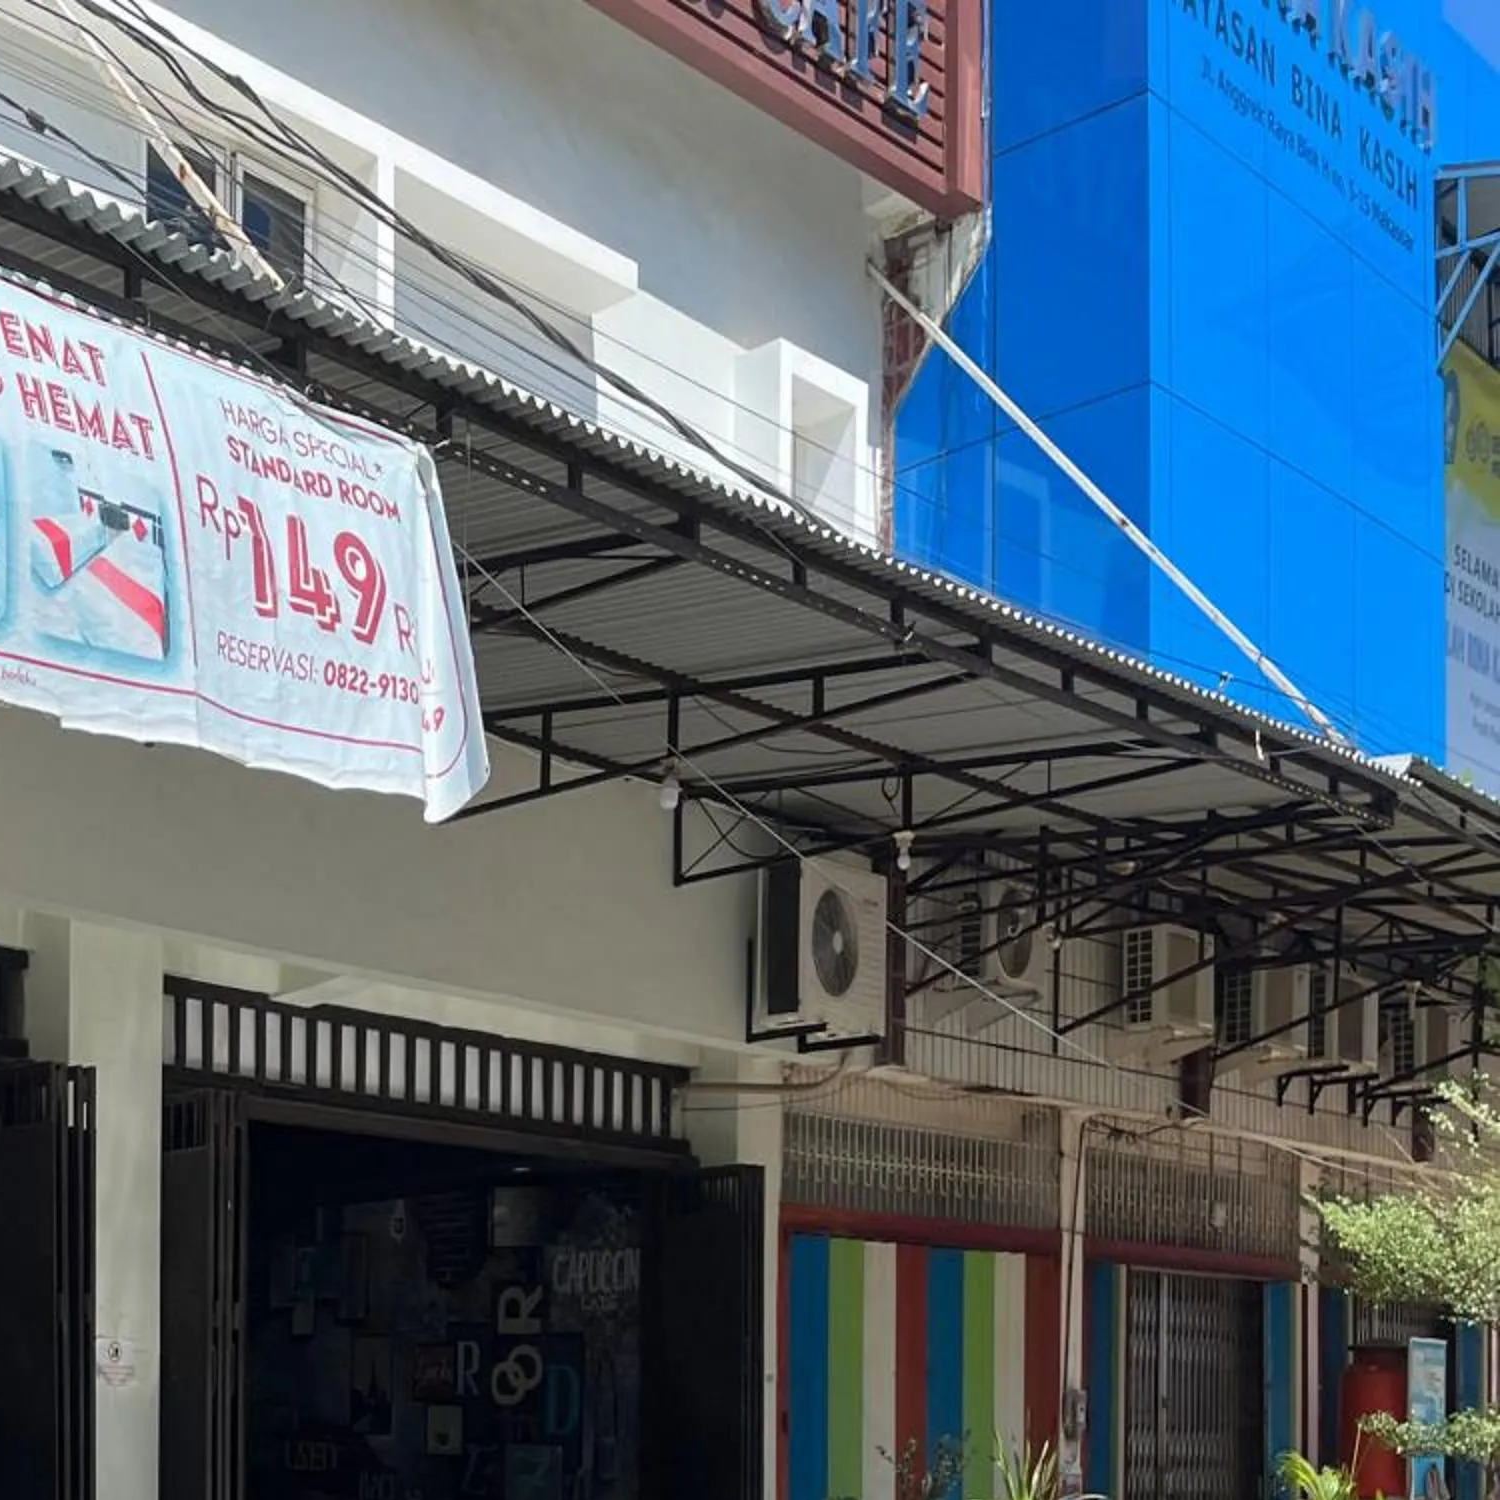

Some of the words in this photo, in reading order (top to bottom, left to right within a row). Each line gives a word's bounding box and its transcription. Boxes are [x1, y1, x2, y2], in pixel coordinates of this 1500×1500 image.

[1172, 0, 1276, 87] AYASAN
[1291, 64, 1342, 142] BINA
[1359, 126, 1418, 210] KASIH
[16, 372, 155, 461] HEMAT
[221, 398, 288, 447] HARGA
[227, 436, 333, 498] STANDARD
[337, 478, 402, 523] ROOM
[238, 496, 388, 645] 149
[1454, 543, 1500, 592] SELAMA
[217, 630, 318, 685] RESERVASI:
